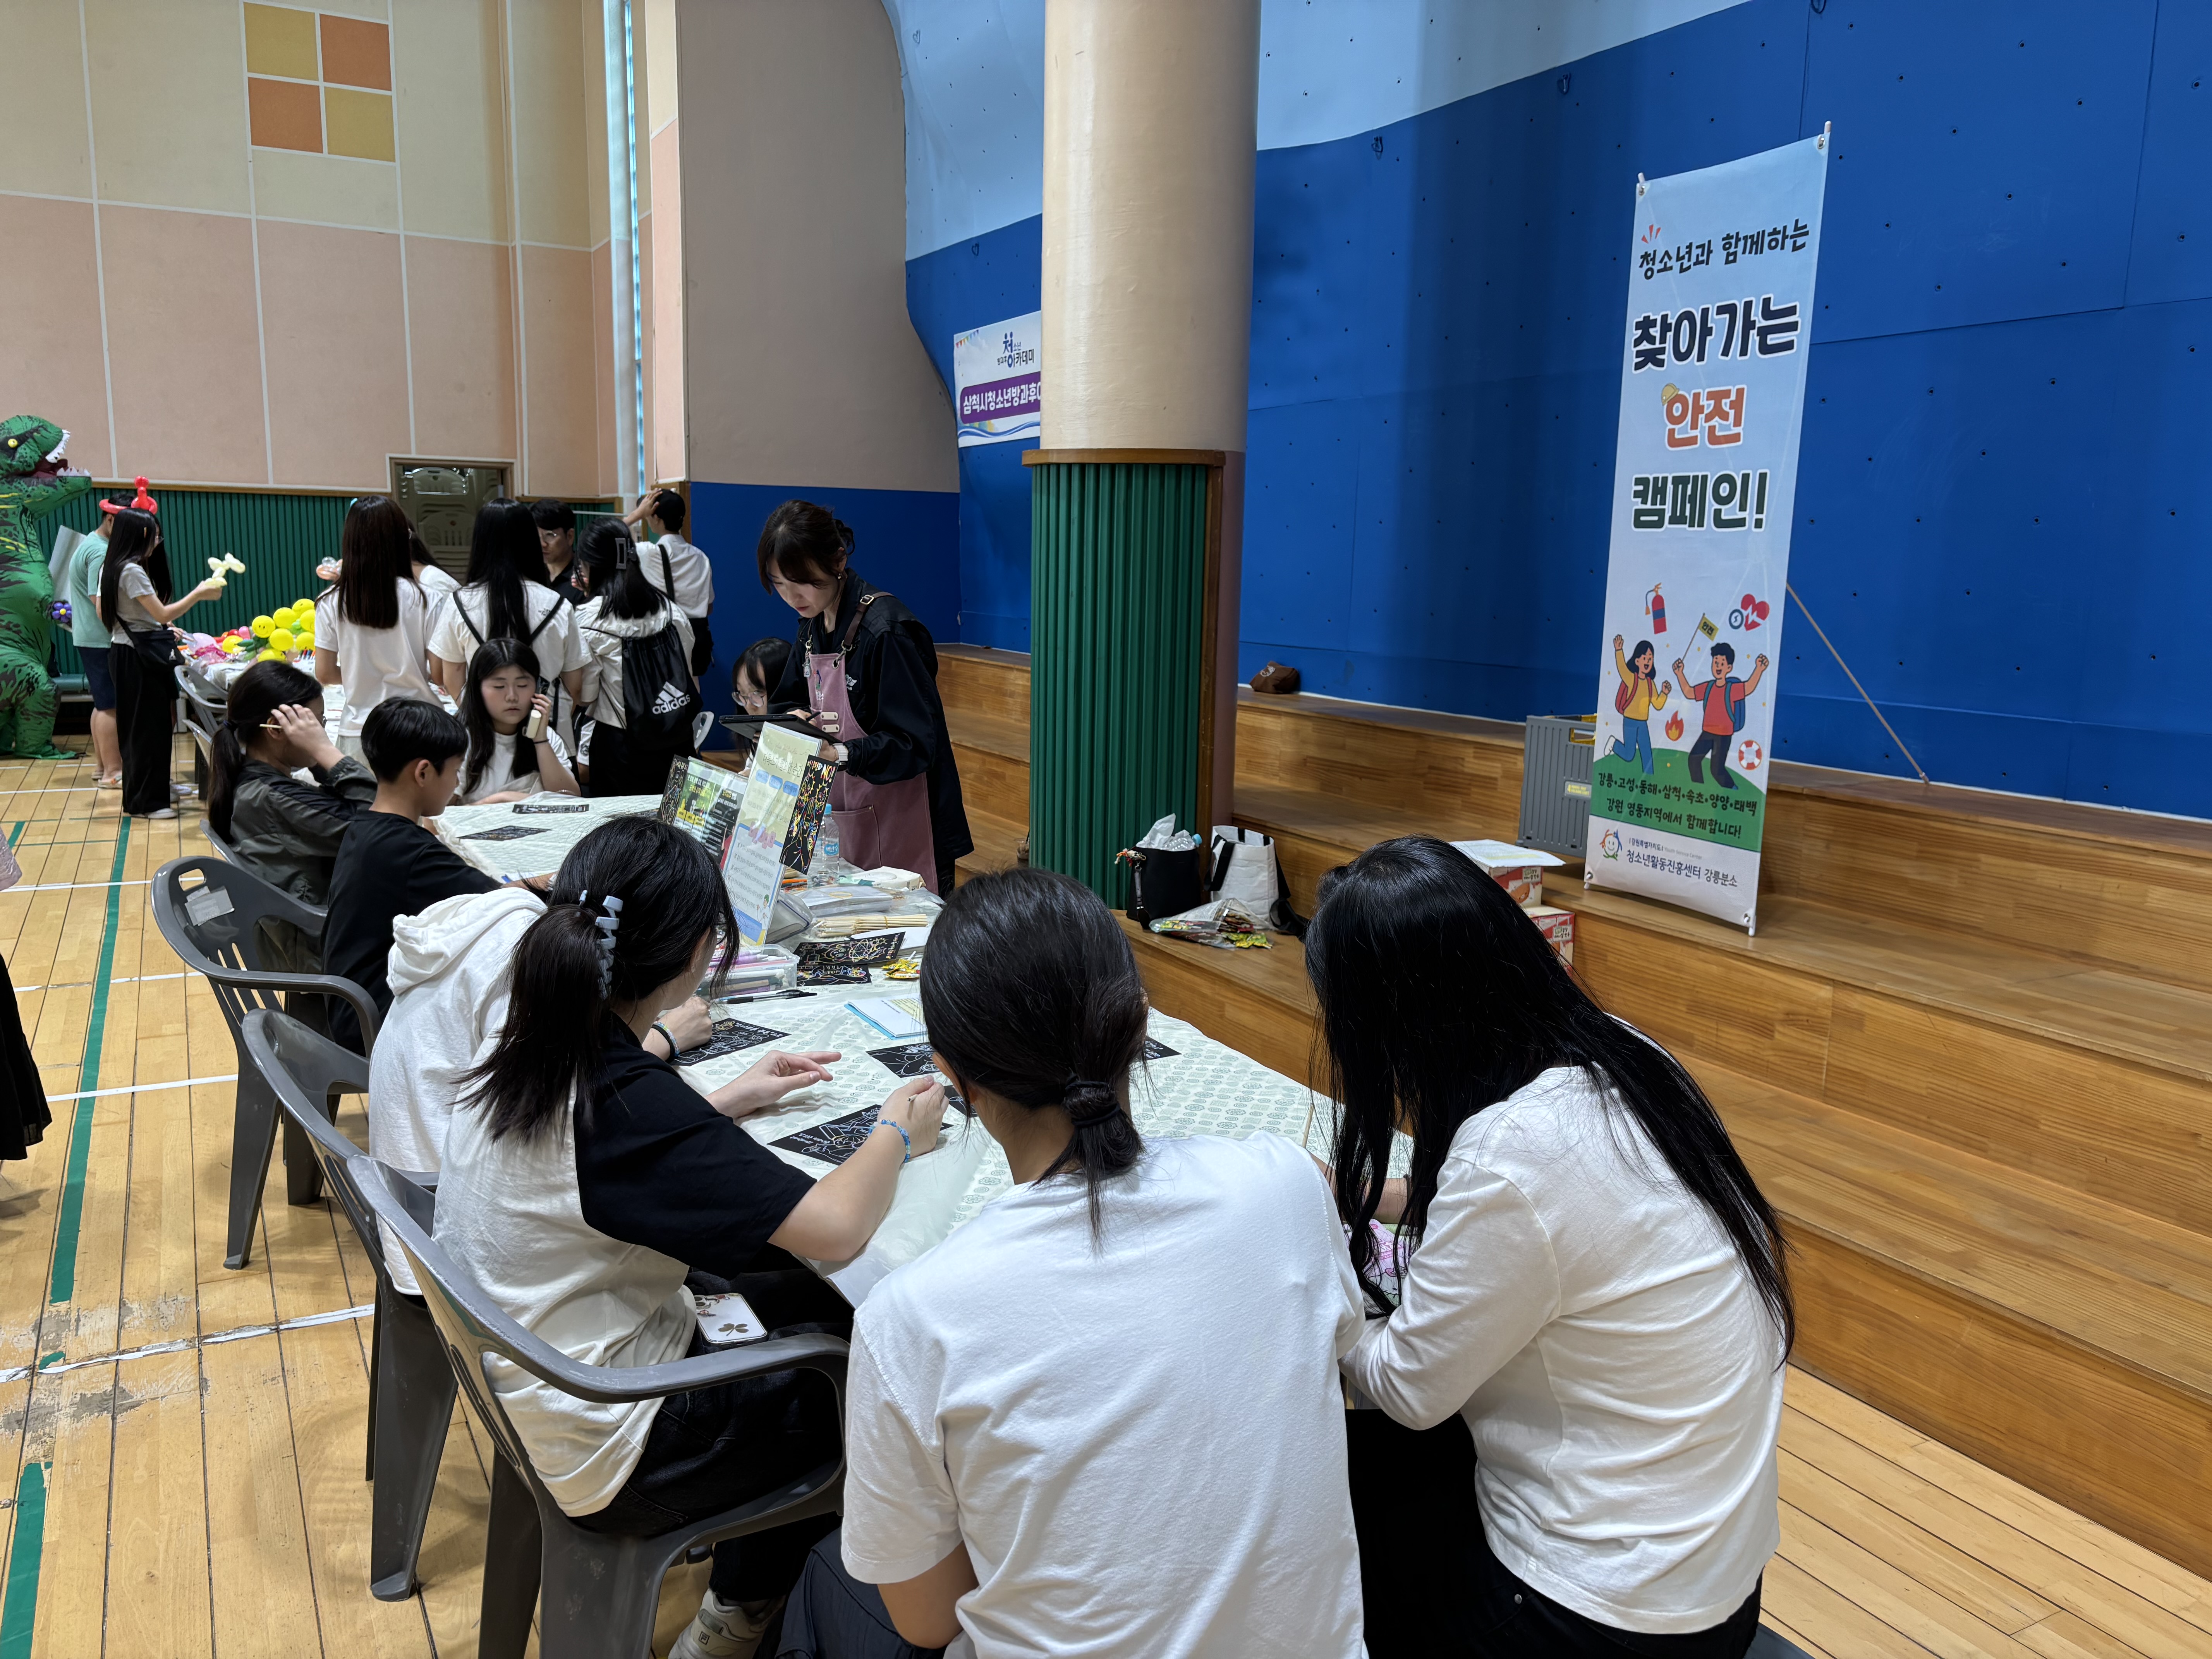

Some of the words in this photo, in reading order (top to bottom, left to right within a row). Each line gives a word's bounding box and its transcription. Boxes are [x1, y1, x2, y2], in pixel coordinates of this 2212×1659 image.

[1639, 239, 1713, 280] 청소년과
[1722, 218, 1809, 265] 함께하는
[1632, 295, 1800, 372] 찾아가는
[1666, 387, 1745, 448] 안전
[1633, 472, 1767, 529] 캠페인!
[652, 694, 690, 714] adidas
[821, 764, 836, 783] NO!
[1607, 798, 1623, 813] 강원
[1627, 802, 1682, 825] 영동지역에서
[1687, 814, 1742, 839] 함께합니다!
[1626, 849, 1701, 879] 청소년활동진흥센터
[1704, 868, 1738, 887] 강릉분소
